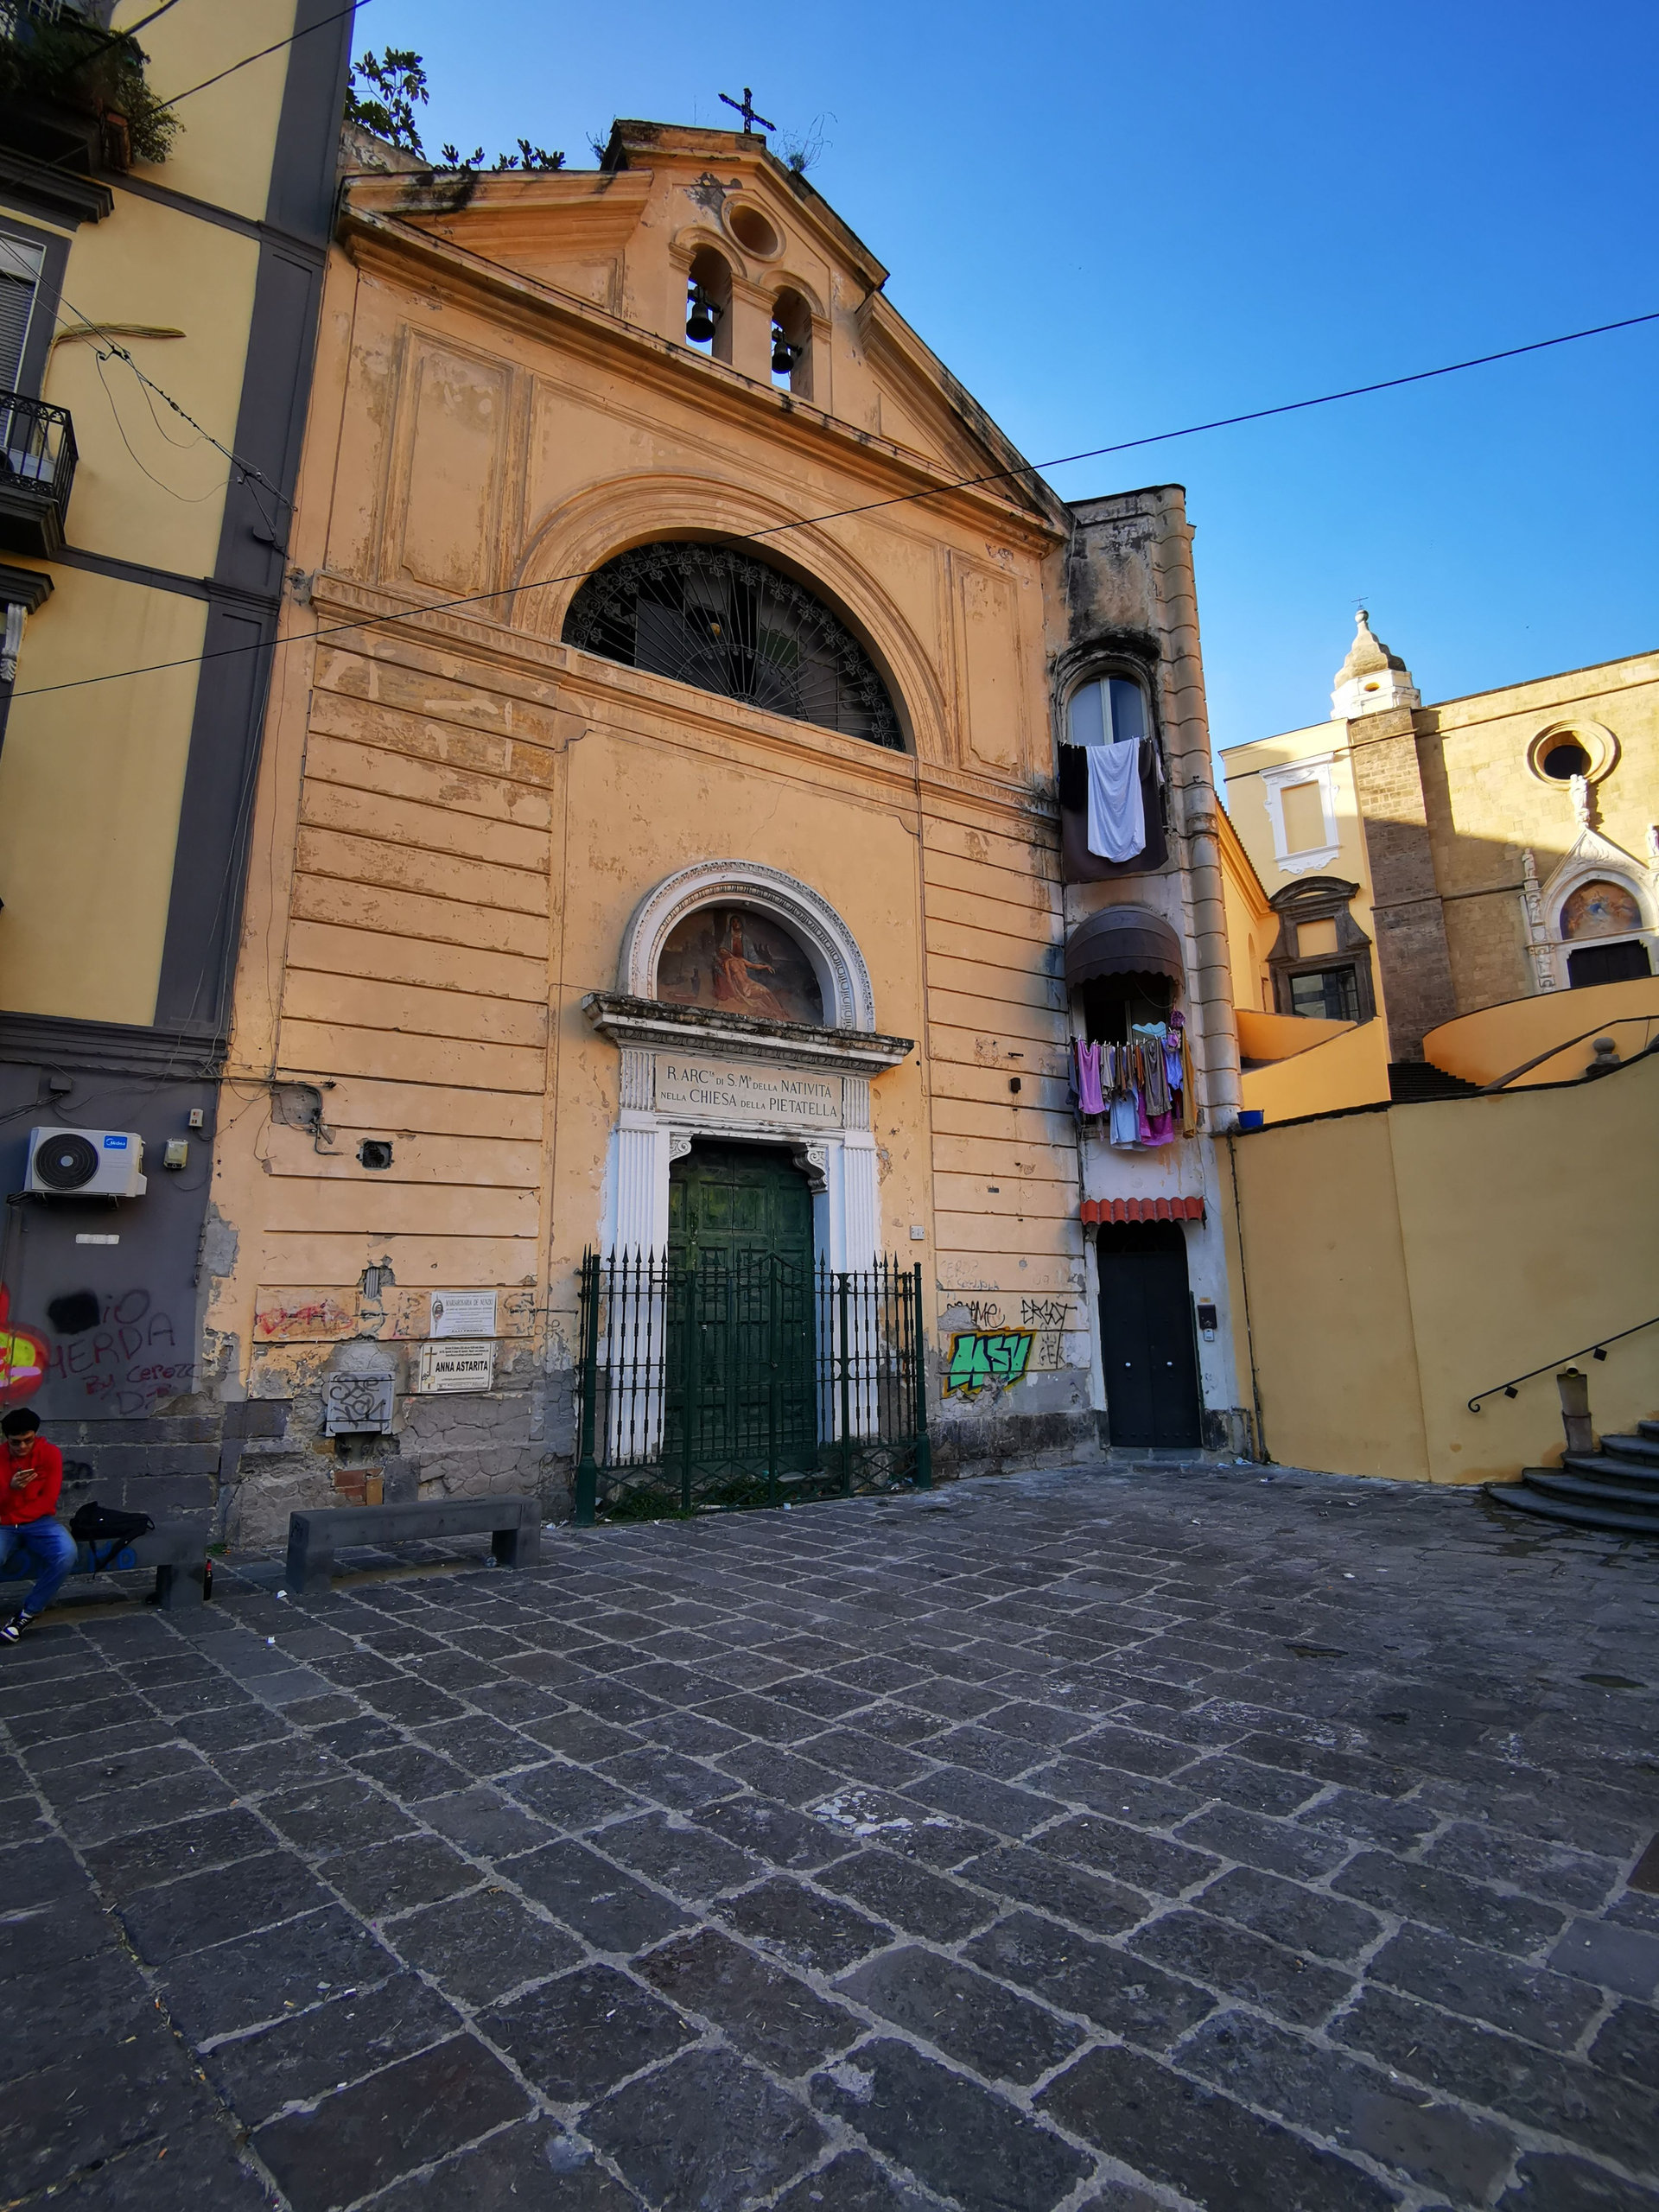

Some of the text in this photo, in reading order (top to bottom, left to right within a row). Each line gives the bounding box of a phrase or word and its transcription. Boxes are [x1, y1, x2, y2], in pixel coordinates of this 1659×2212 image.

[753, 1082, 778, 1092] DELLA
[660, 1089, 837, 1118] NELLA CHIESA DELLA PIETATELLA
[435, 1360, 488, 1372] ANNA ASTARITA
